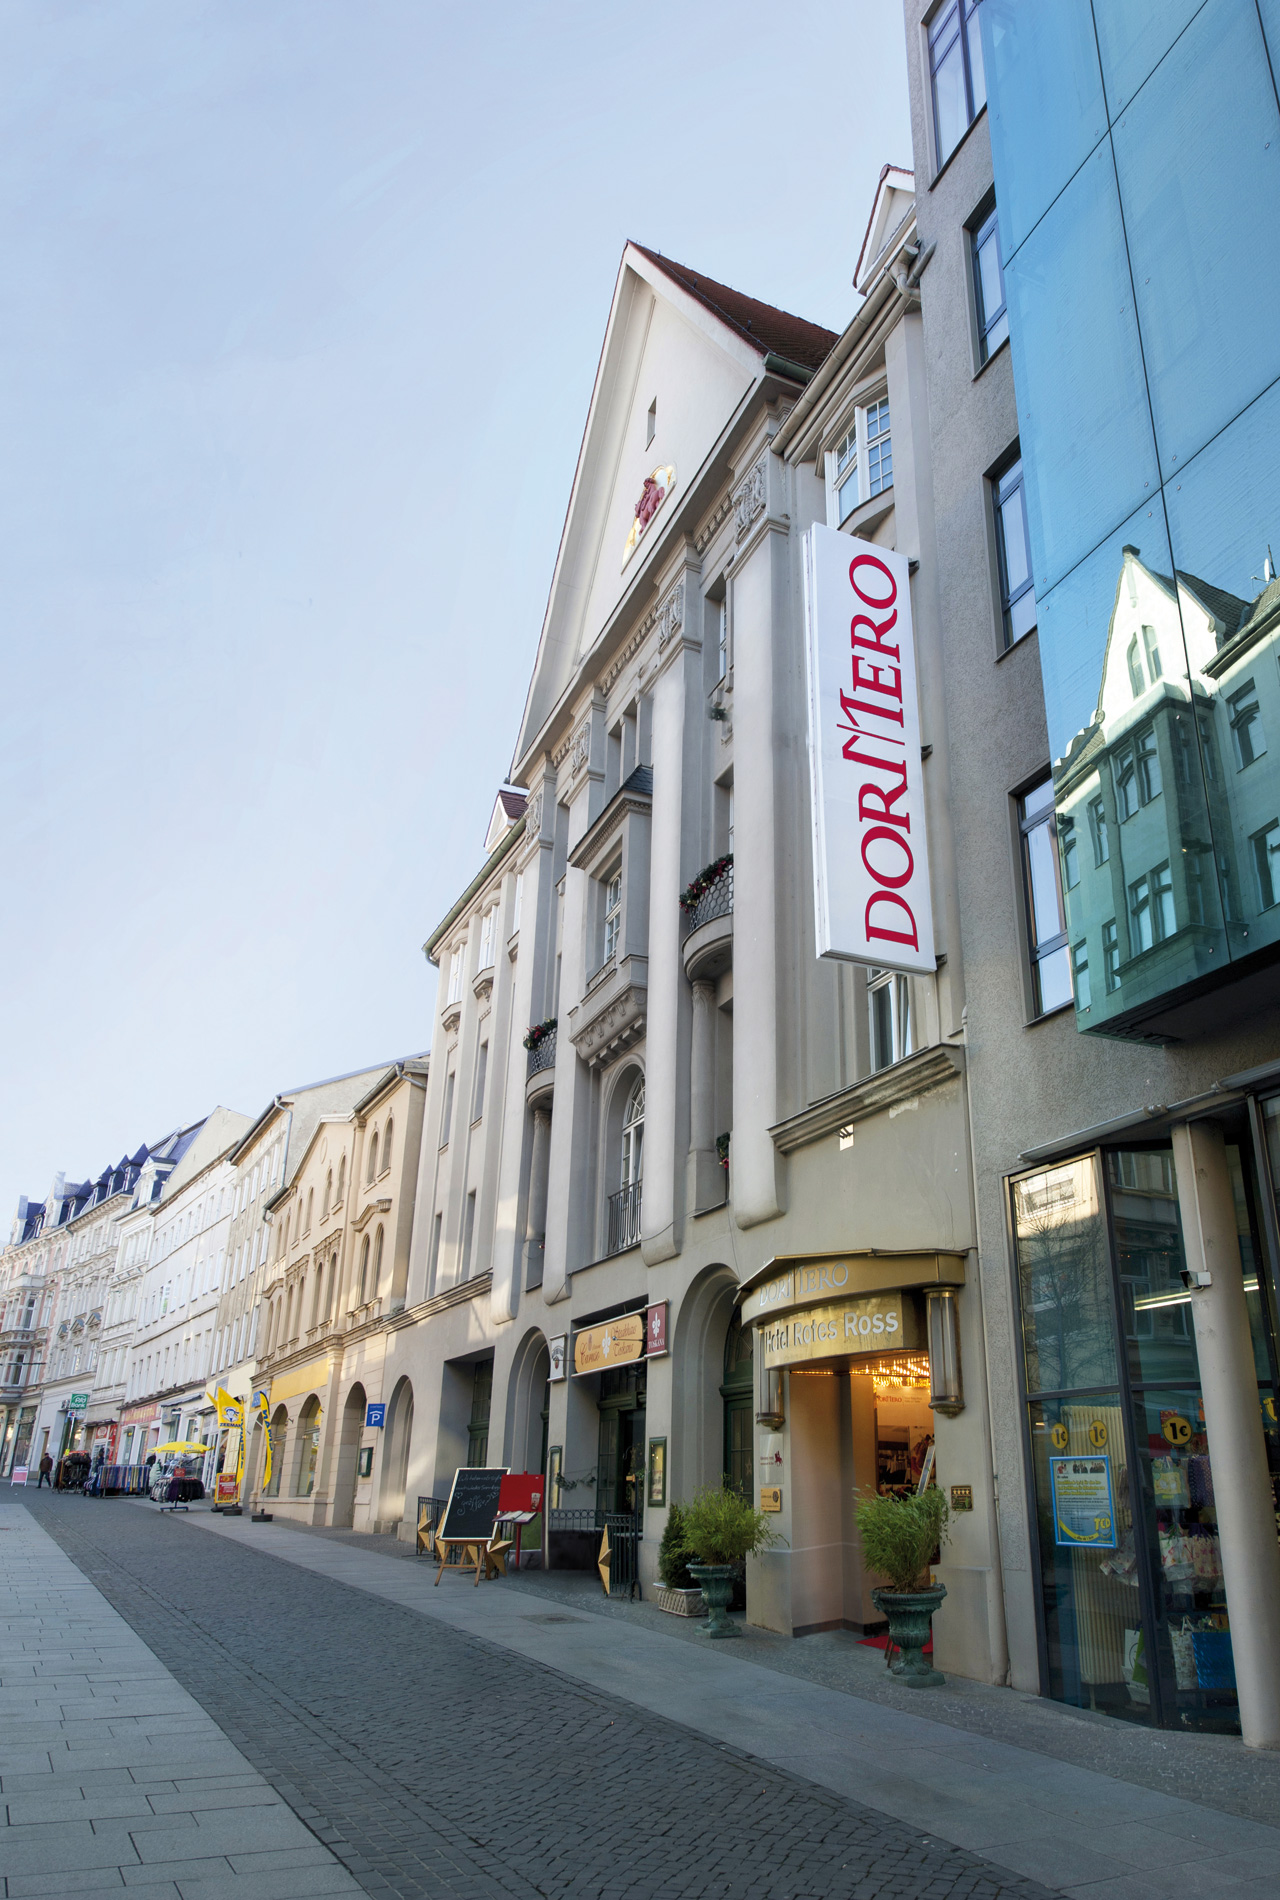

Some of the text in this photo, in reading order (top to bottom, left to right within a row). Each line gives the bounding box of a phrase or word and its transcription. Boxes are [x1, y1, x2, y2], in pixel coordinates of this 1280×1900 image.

[837, 554, 919, 953] DORMERO
[760, 1262, 848, 1307] DORMERO
[765, 1311, 899, 1354] Hotel Rotes Ross
